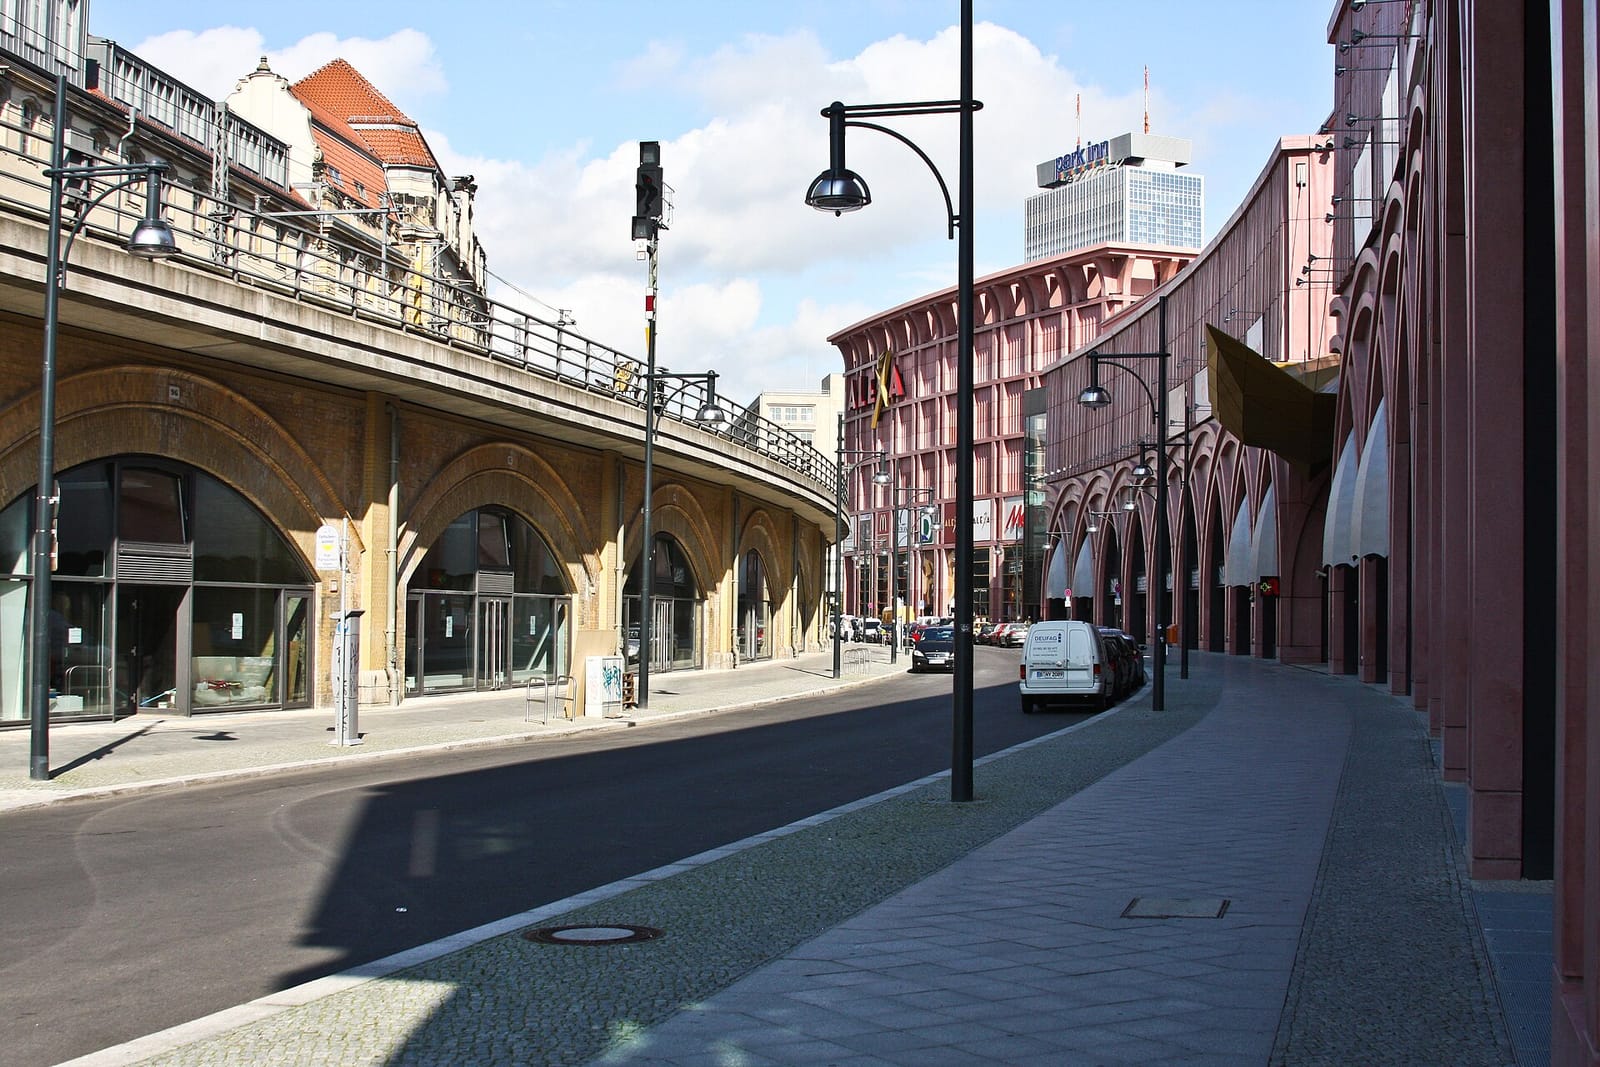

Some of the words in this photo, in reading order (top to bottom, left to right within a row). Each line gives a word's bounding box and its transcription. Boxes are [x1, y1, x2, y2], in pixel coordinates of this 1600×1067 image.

[1056, 144, 1085, 179] park
[1087, 141, 1109, 162] inn
[848, 350, 905, 429] ALEXA
